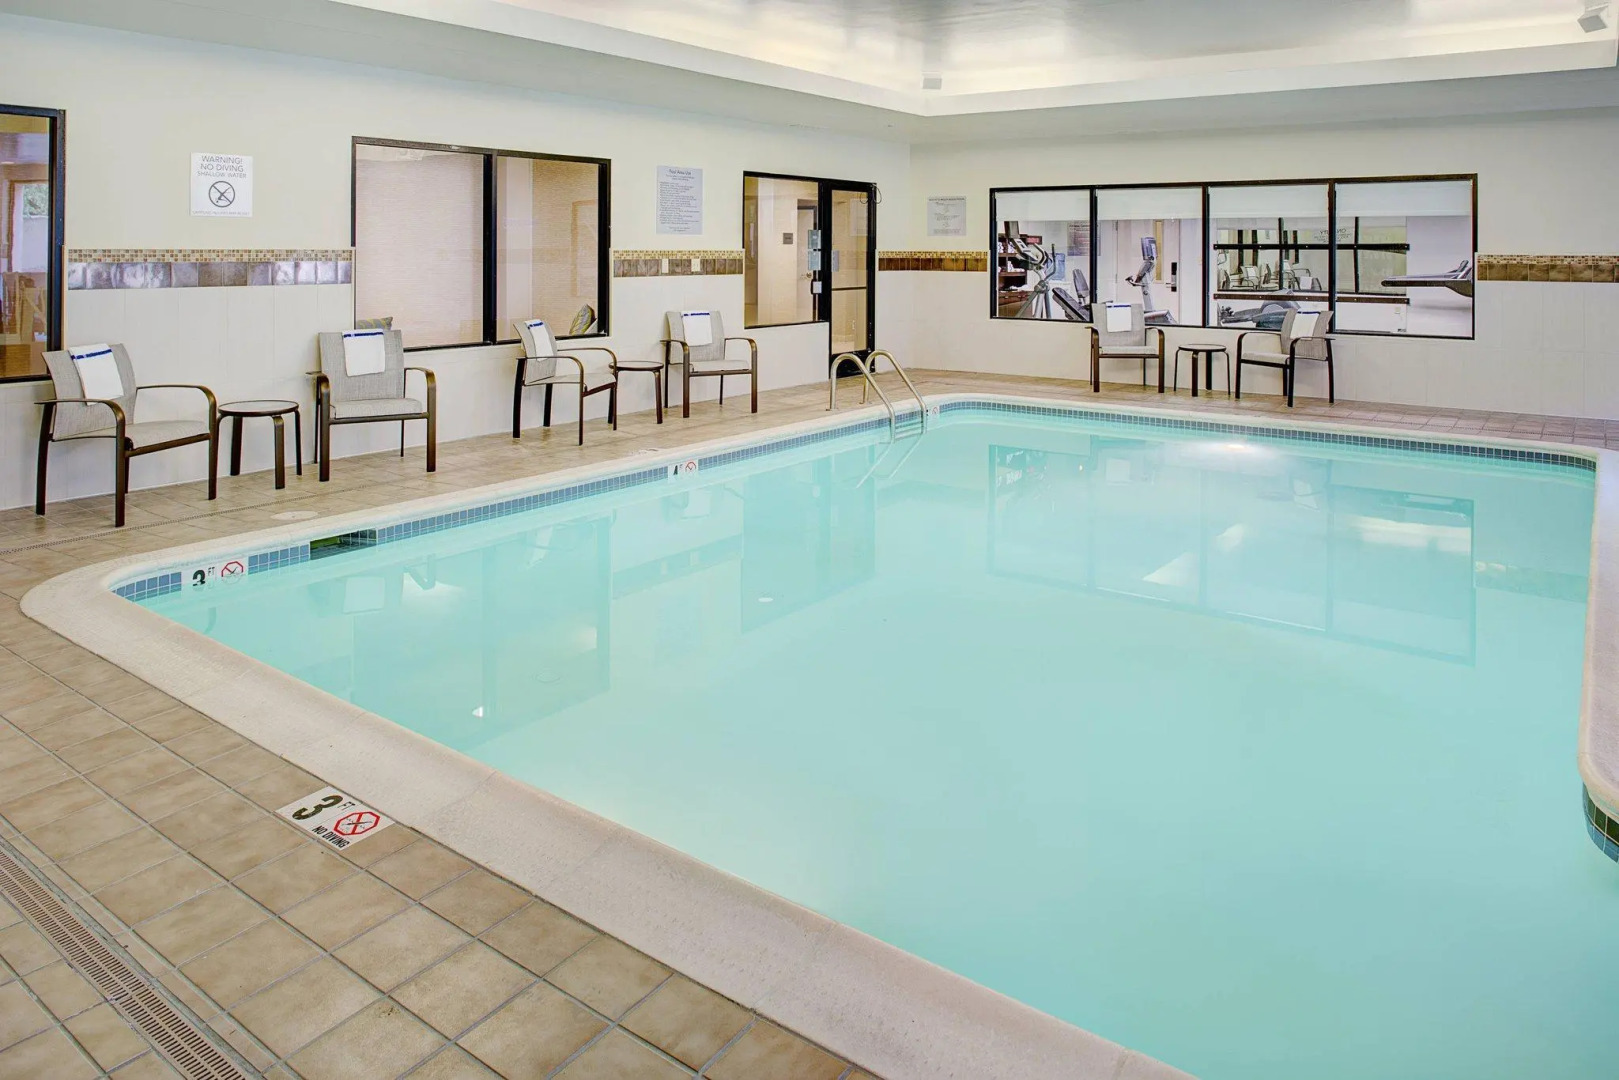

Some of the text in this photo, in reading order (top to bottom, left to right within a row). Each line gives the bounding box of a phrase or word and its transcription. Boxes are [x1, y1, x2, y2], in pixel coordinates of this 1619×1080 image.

[201, 155, 243, 165] WARNING!
[200, 163, 244, 173] NO DIVING
[197, 170, 247, 180] SHALLOW WATER
[192, 569, 206, 586] 3
[291, 794, 356, 821] 3 FT
[312, 825, 350, 849] NO DIVING
